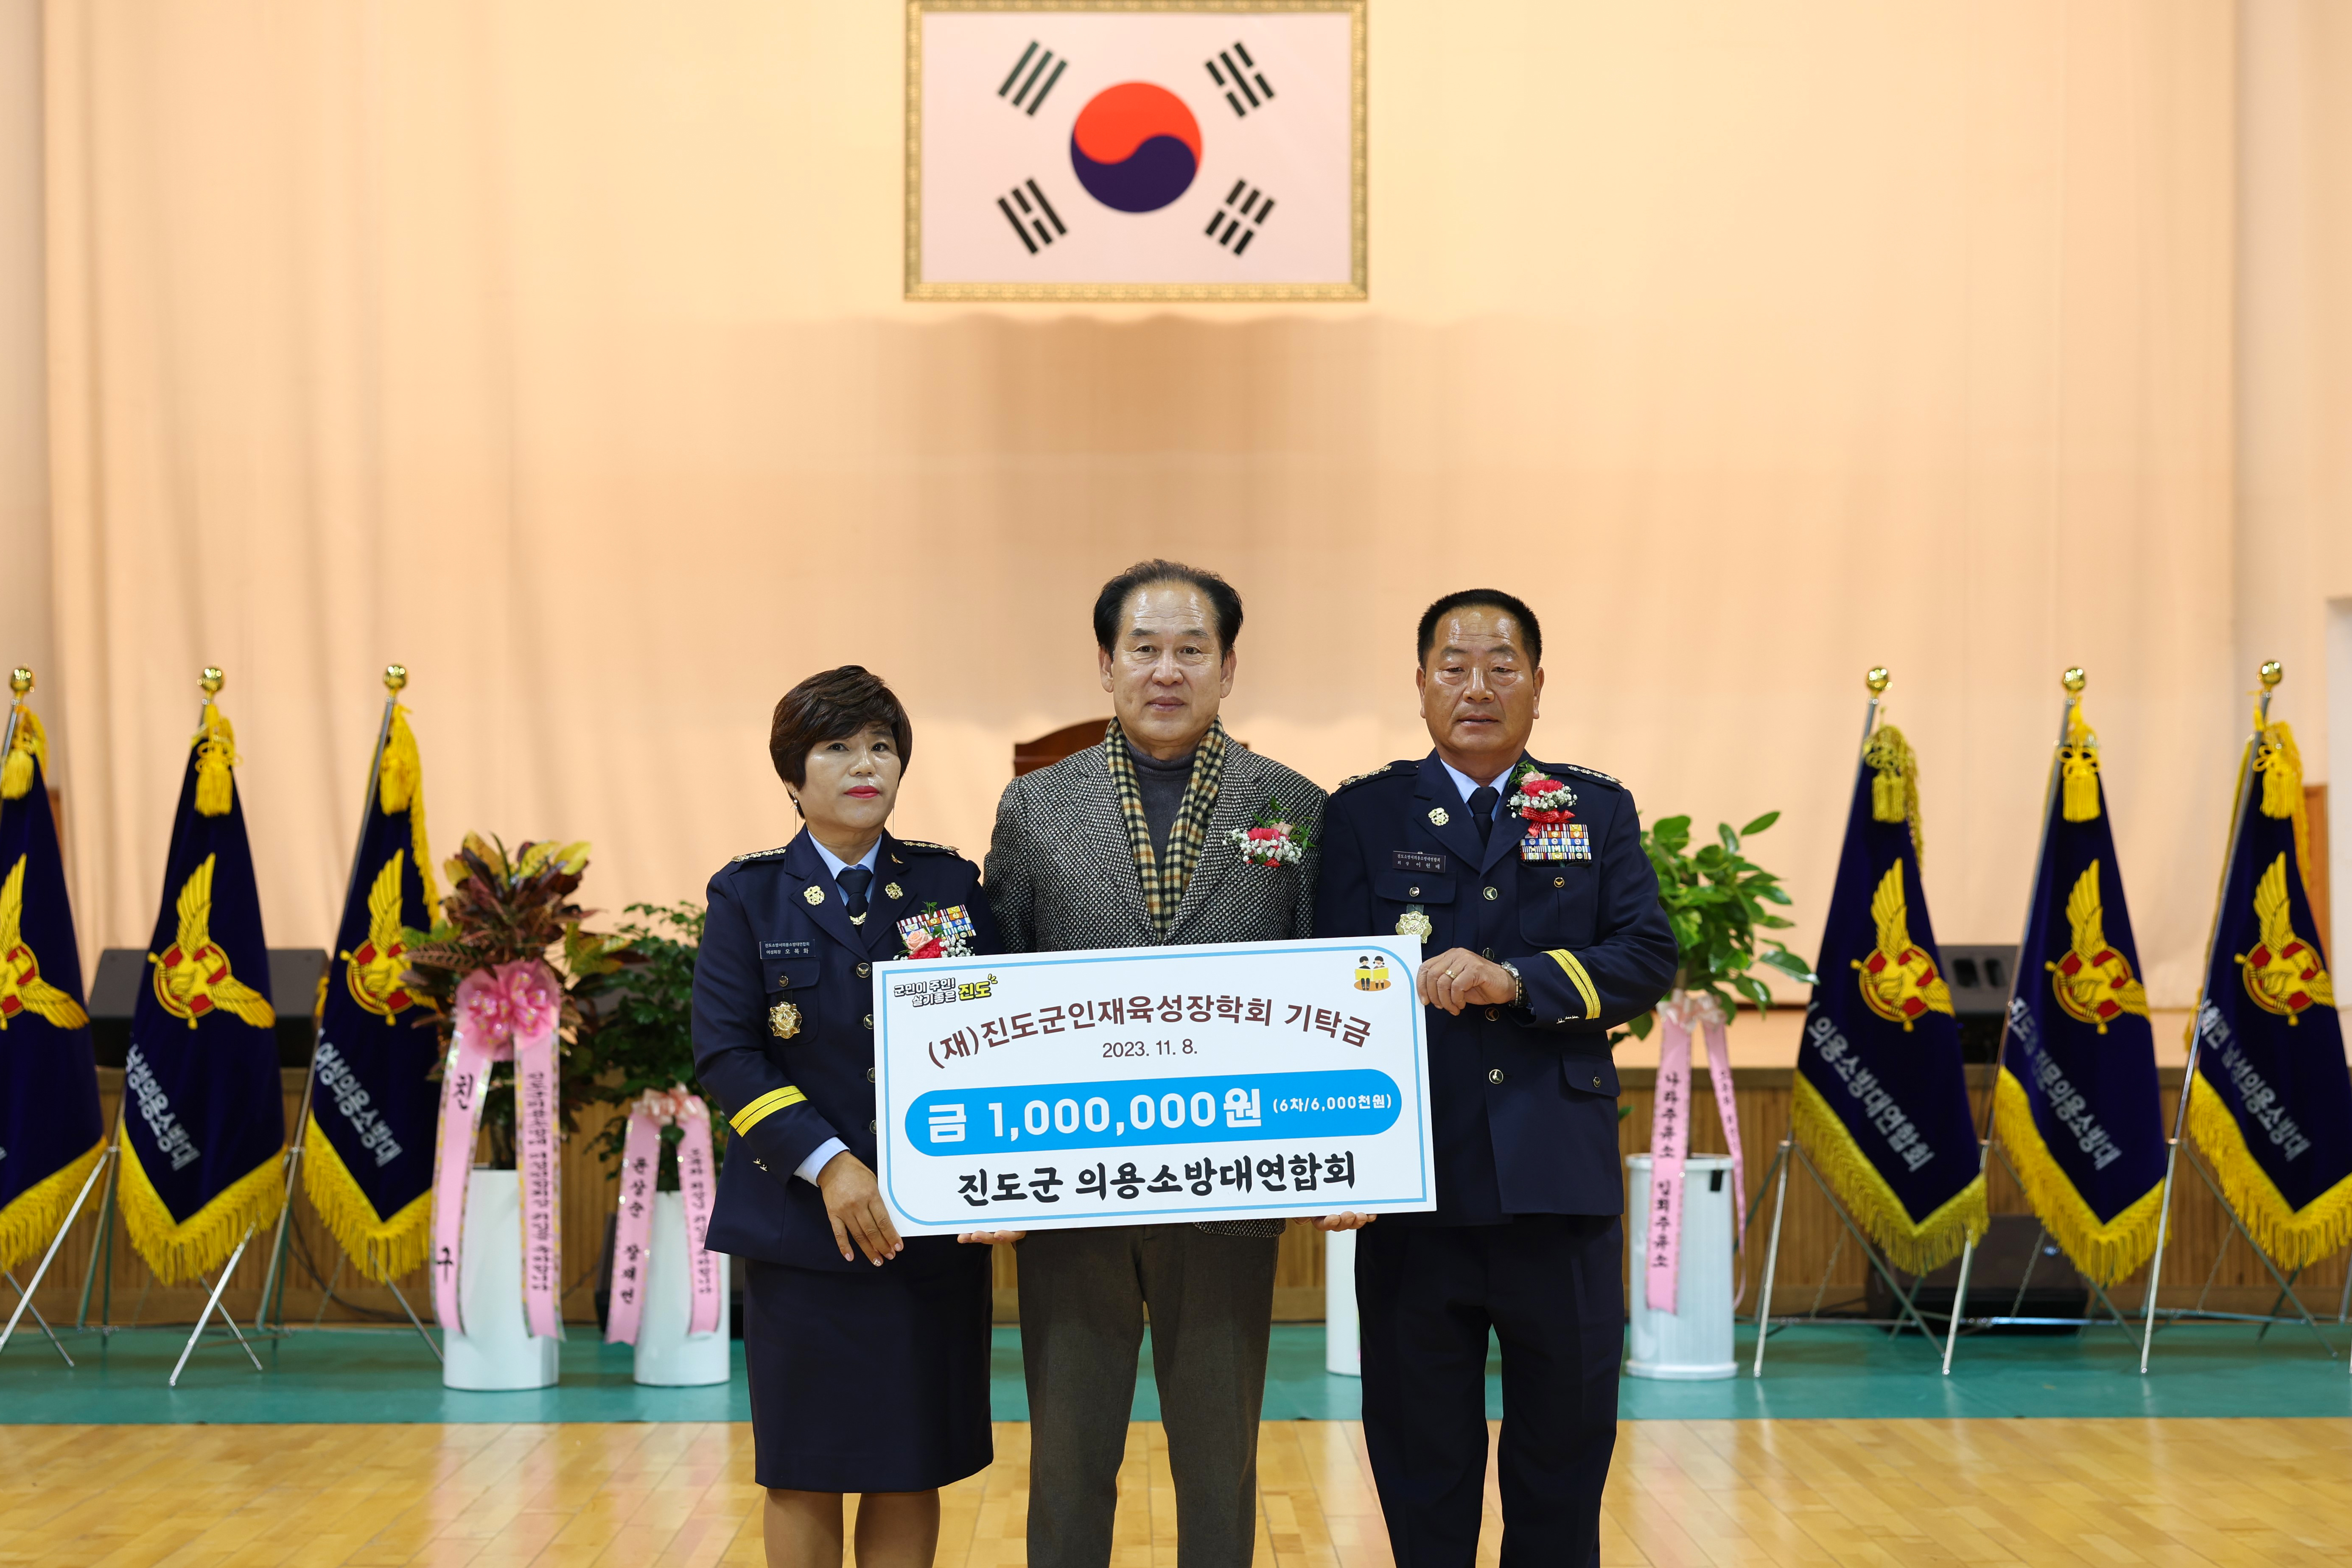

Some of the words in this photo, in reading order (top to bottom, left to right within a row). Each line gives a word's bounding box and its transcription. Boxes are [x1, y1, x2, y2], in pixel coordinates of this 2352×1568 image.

[894, 981, 927, 997] 군민이
[929, 977, 955, 991] 주인!
[912, 991, 956, 1007] 살기좋은
[958, 981, 991, 1001] 진도
[929, 994, 1272, 1069] (재)진도군인재육성장학회
[1284, 1005, 1371, 1048] 기탁금
[1103, 1041, 1150, 1058] 2023.
[1156, 1040, 1176, 1055] 11.
[1182, 1039, 1198, 1054] 8.
[315, 1042, 403, 1167] 여성의용소방대
[928, 1103, 966, 1143] 금
[988, 1088, 1261, 1142] 1,000,000원
[1273, 1094, 1391, 1113] (6차/6,000천원)
[1807, 1016, 1935, 1172] 의용소방대연합회
[957, 1167, 1064, 1207] 진도군
[1075, 1151, 1355, 1201] 의용소방대연합회
